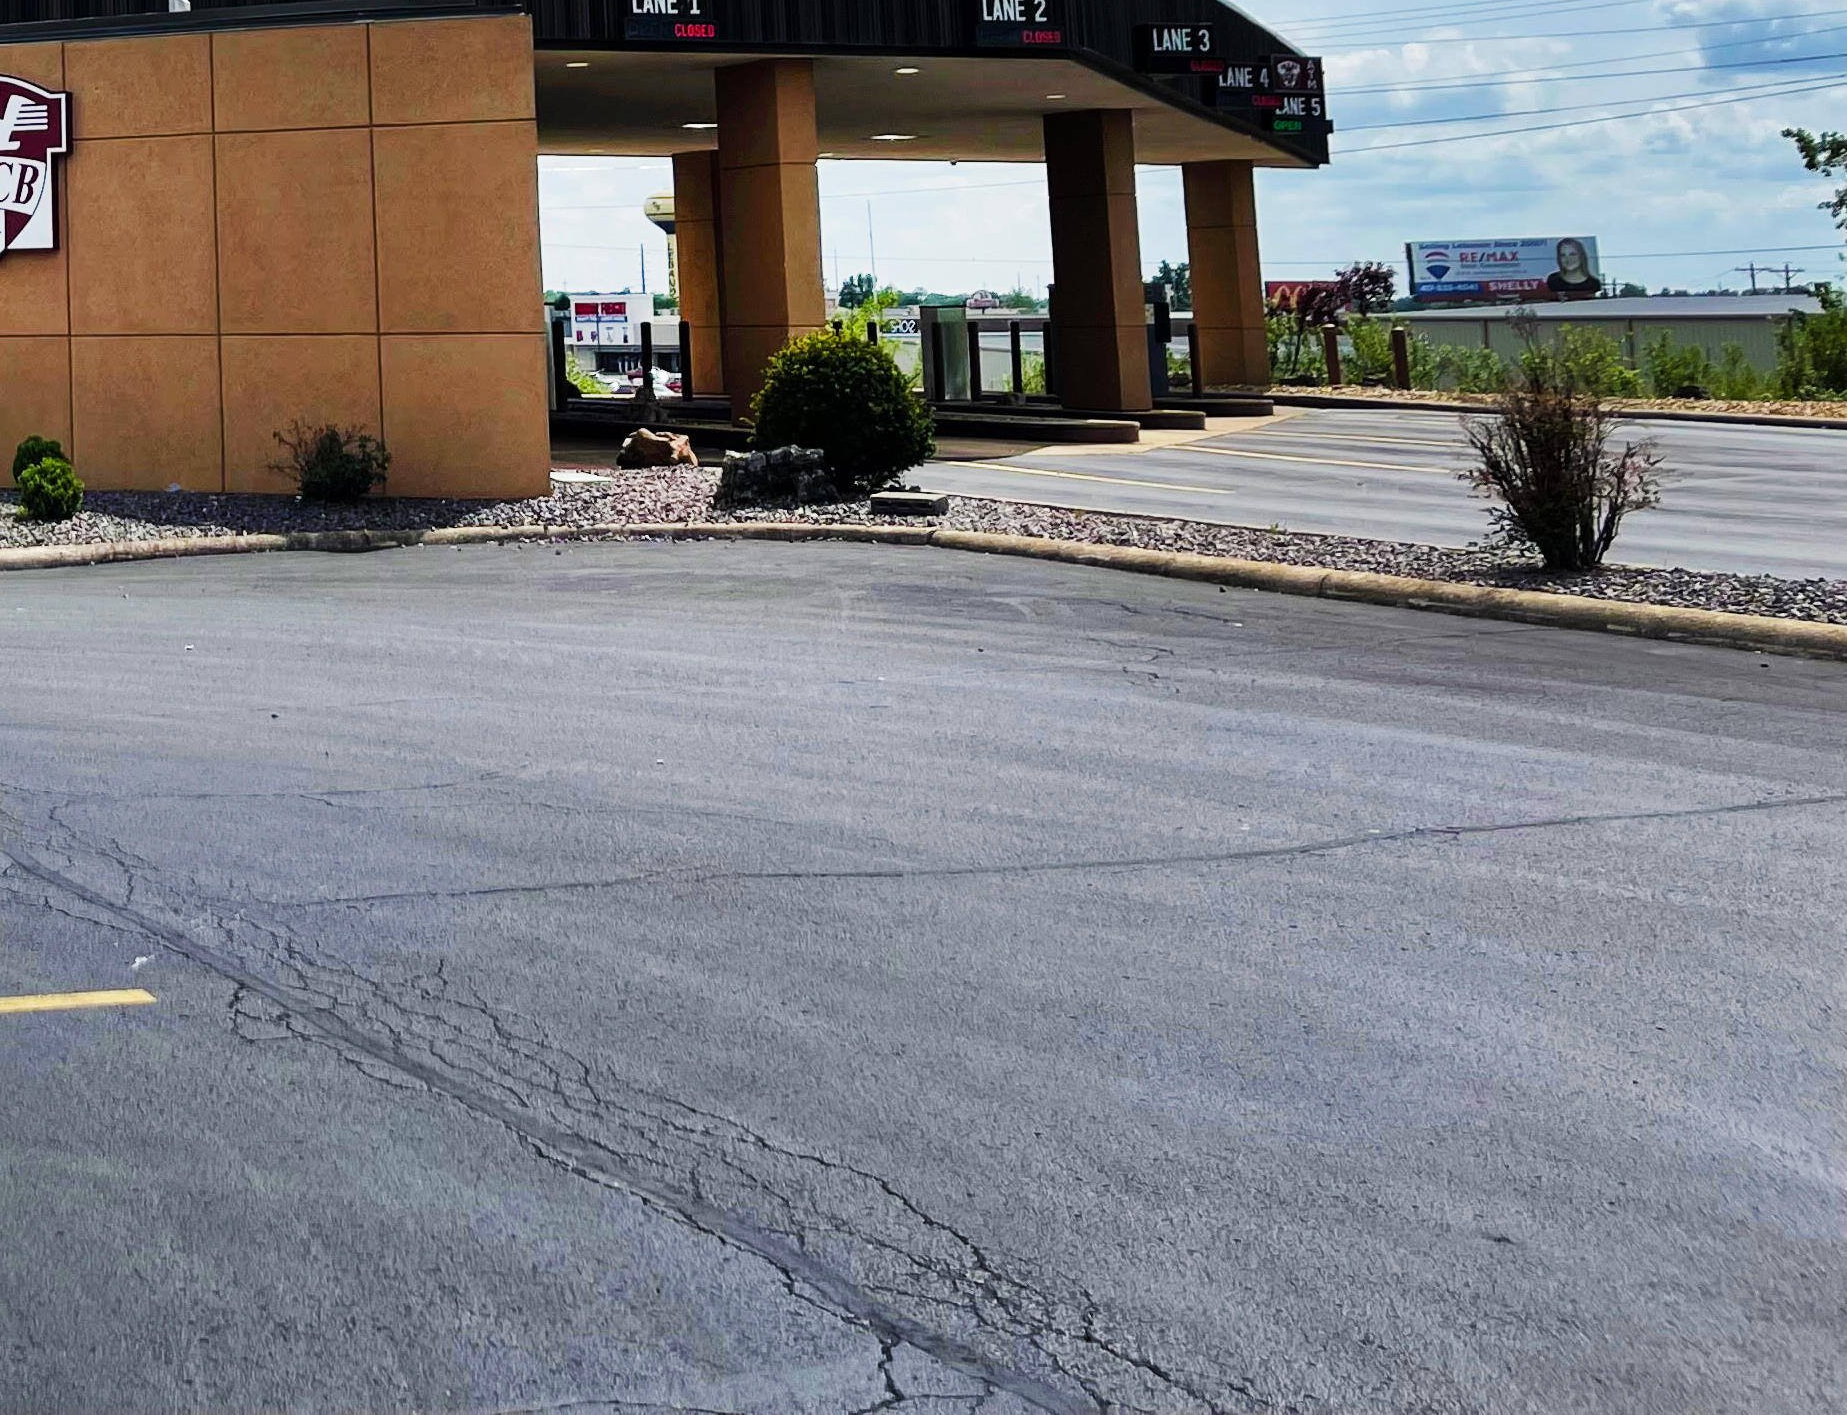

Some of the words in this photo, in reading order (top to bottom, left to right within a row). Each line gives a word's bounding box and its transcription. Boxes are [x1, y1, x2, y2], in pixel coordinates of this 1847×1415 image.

[674, 23, 715, 38] CLOSED
[1022, 30, 1061, 43] CLOSED
[1153, 28, 1192, 51] LANE
[1198, 29, 1210, 52] 3
[1218, 66, 1253, 87] LANE
[1259, 68, 1269, 87] 4
[1311, 98, 1320, 116] 5
[1274, 120, 1302, 130] OPEN
[1459, 251, 1519, 262] RE/MAX
[1488, 280, 1539, 291] SHELLY
